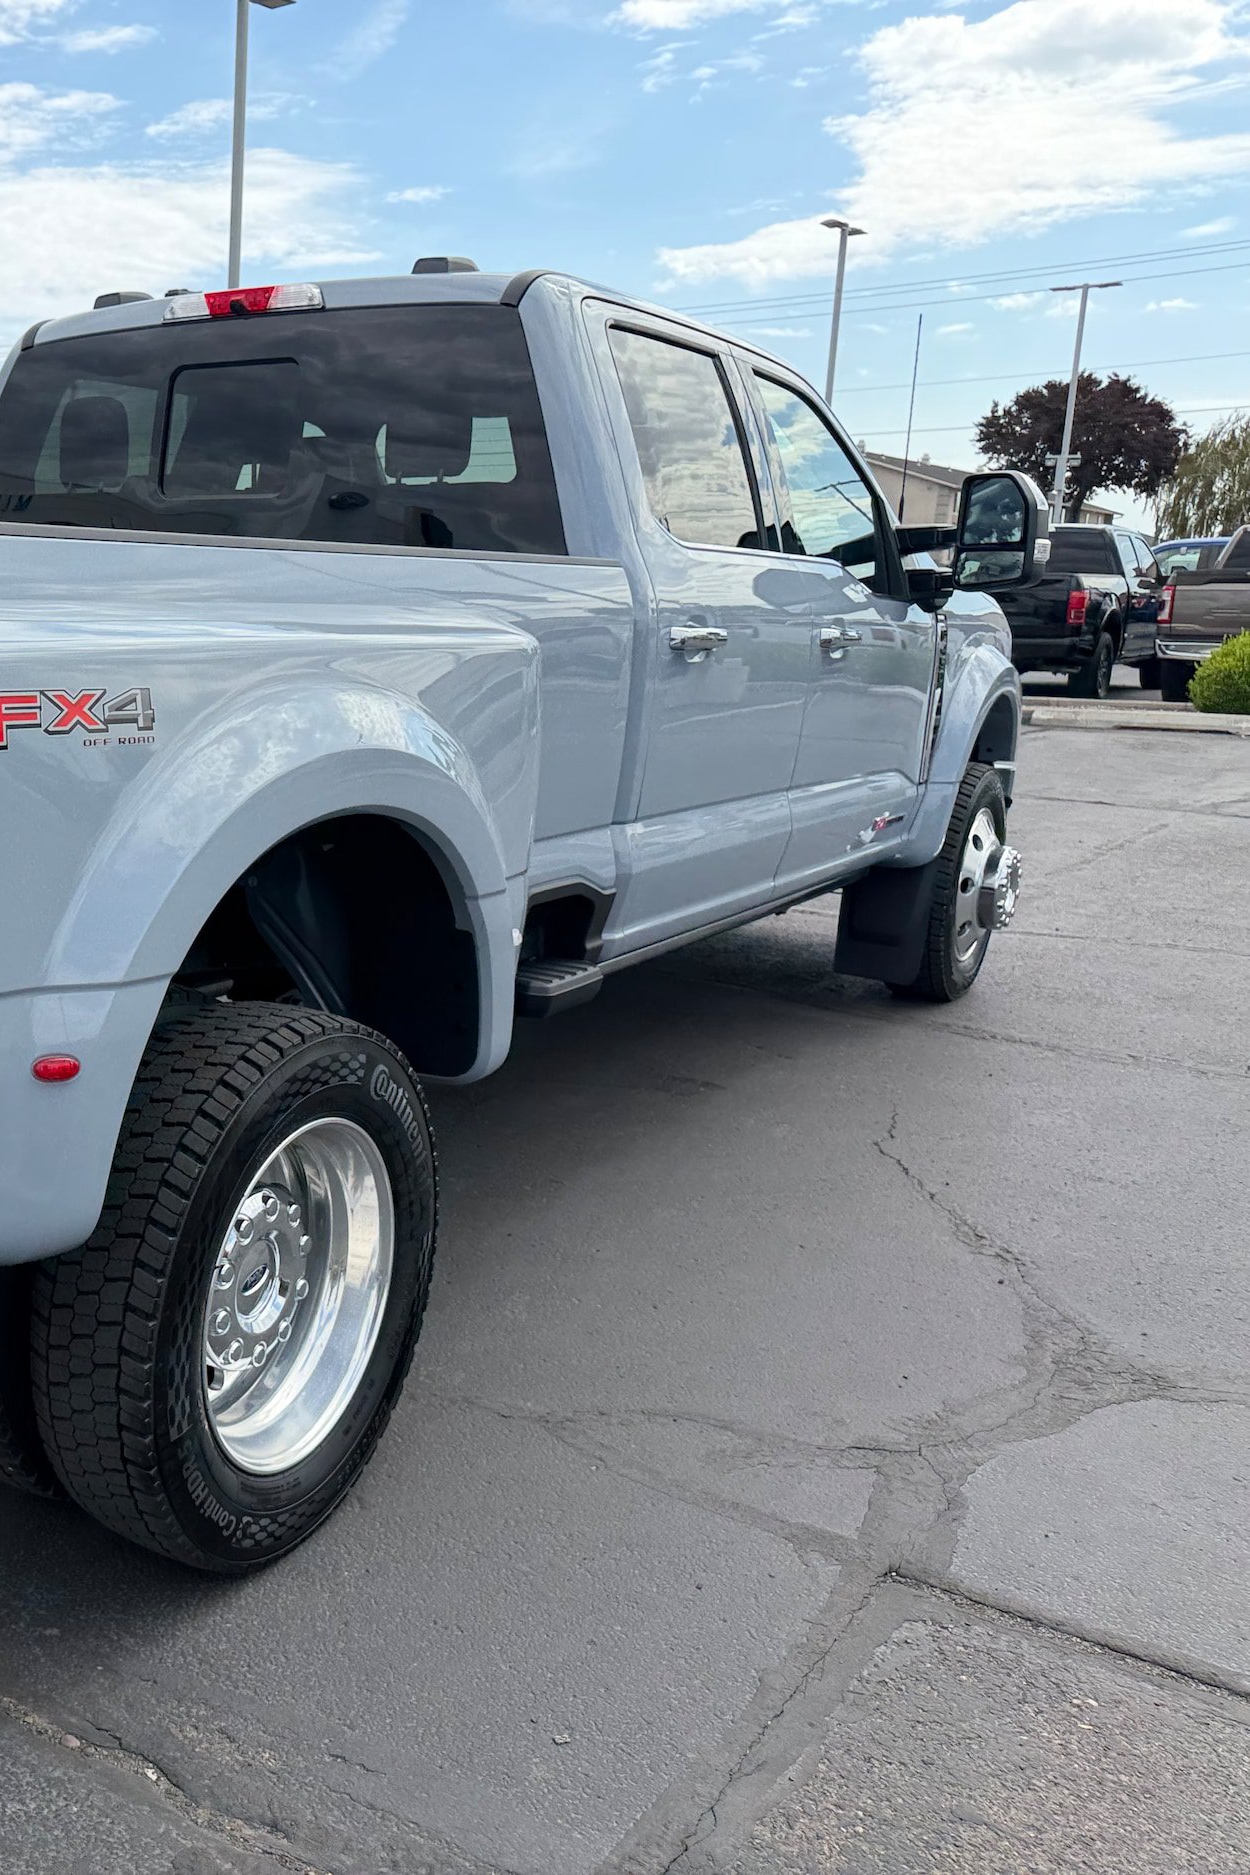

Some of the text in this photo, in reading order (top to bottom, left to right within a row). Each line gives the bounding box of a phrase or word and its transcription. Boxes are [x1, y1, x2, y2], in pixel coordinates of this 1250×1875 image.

[83, 735, 155, 747] OFF ROAD
[200, 1495, 236, 1536] Conti
